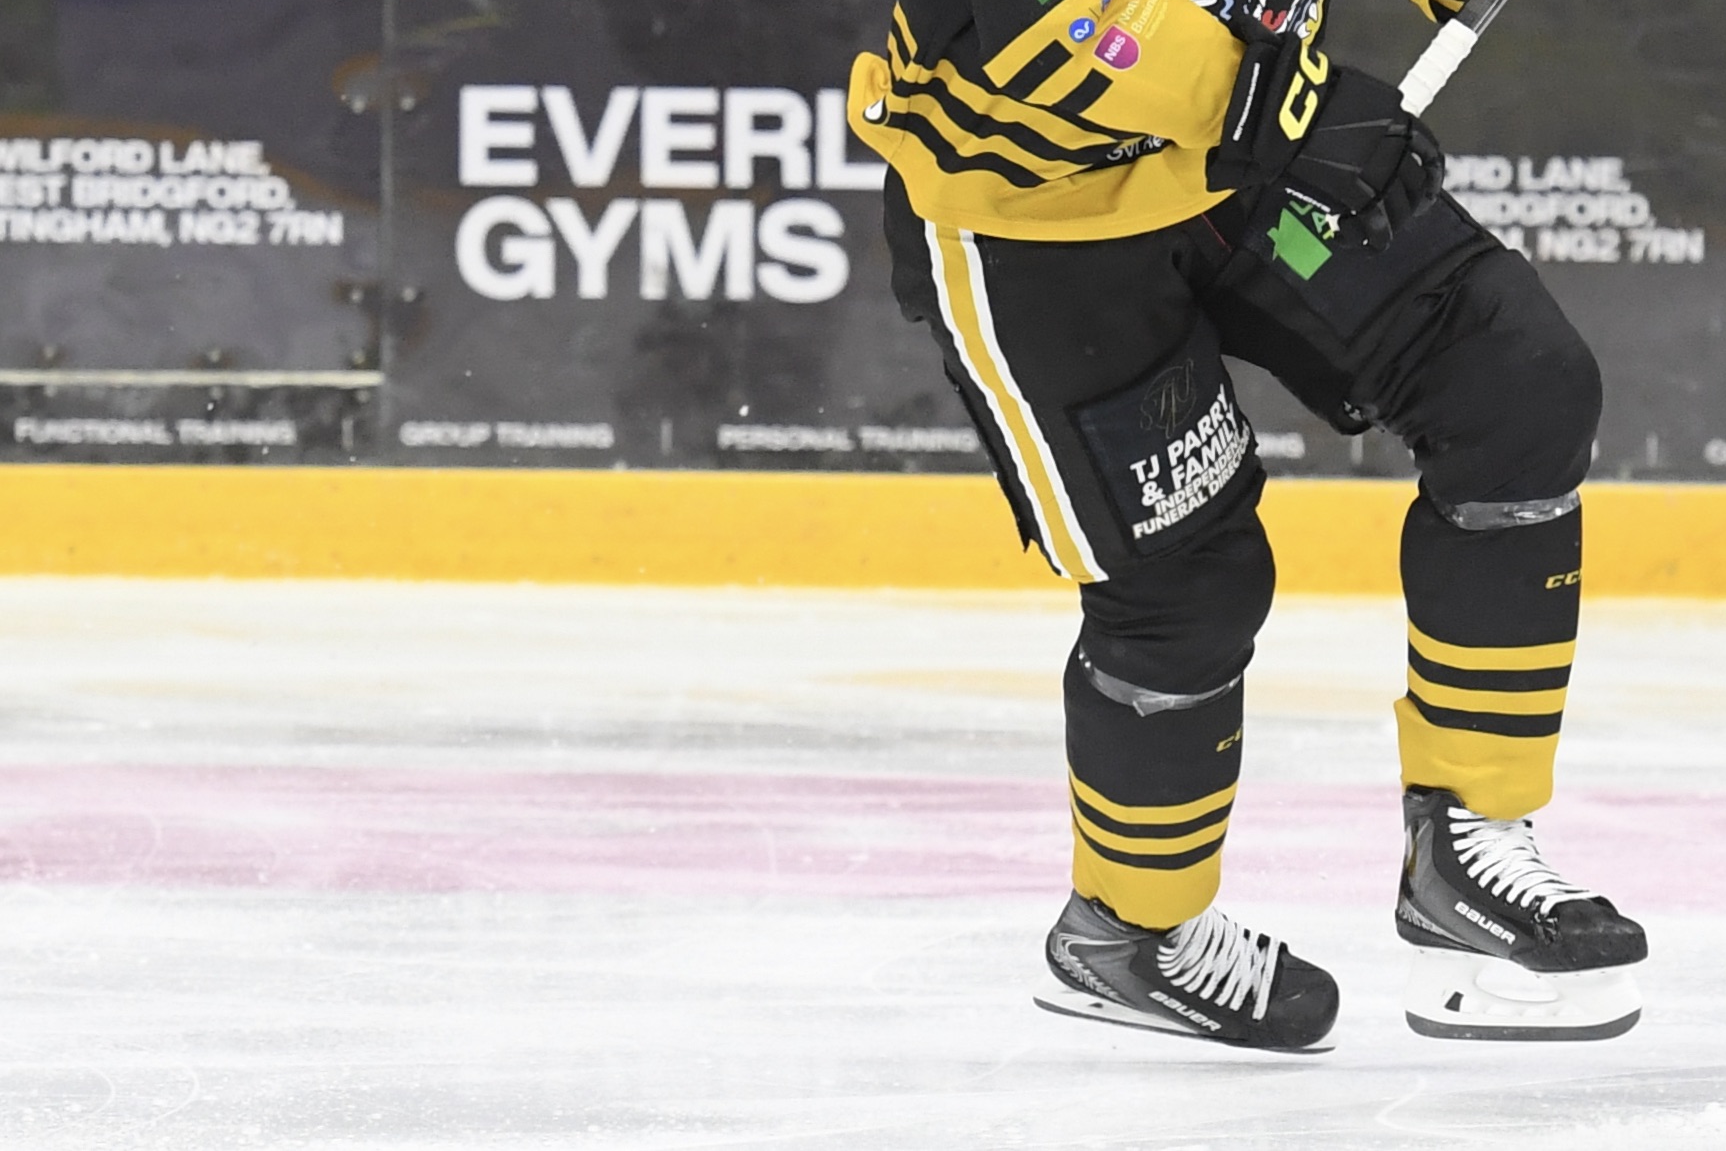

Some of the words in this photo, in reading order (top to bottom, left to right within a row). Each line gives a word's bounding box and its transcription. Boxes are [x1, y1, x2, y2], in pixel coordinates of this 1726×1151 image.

[1104, 34, 1126, 62] NBS
[159, 140, 270, 175] LANE,
[458, 85, 886, 189] EVERL
[1517, 155, 1631, 192] LANE,
[179, 209, 260, 245] NG2
[265, 208, 344, 246] 7RN
[1537, 225, 1621, 263] NG2
[1625, 226, 1705, 264] 7RN
[455, 196, 852, 303] GYMS
[1129, 454, 1160, 484] TJ
[1167, 383, 1228, 467] PARRY
[1141, 481, 1166, 507] &
[1171, 402, 1238, 491] FAMILY
[1132, 493, 1209, 540] FUNERAL
